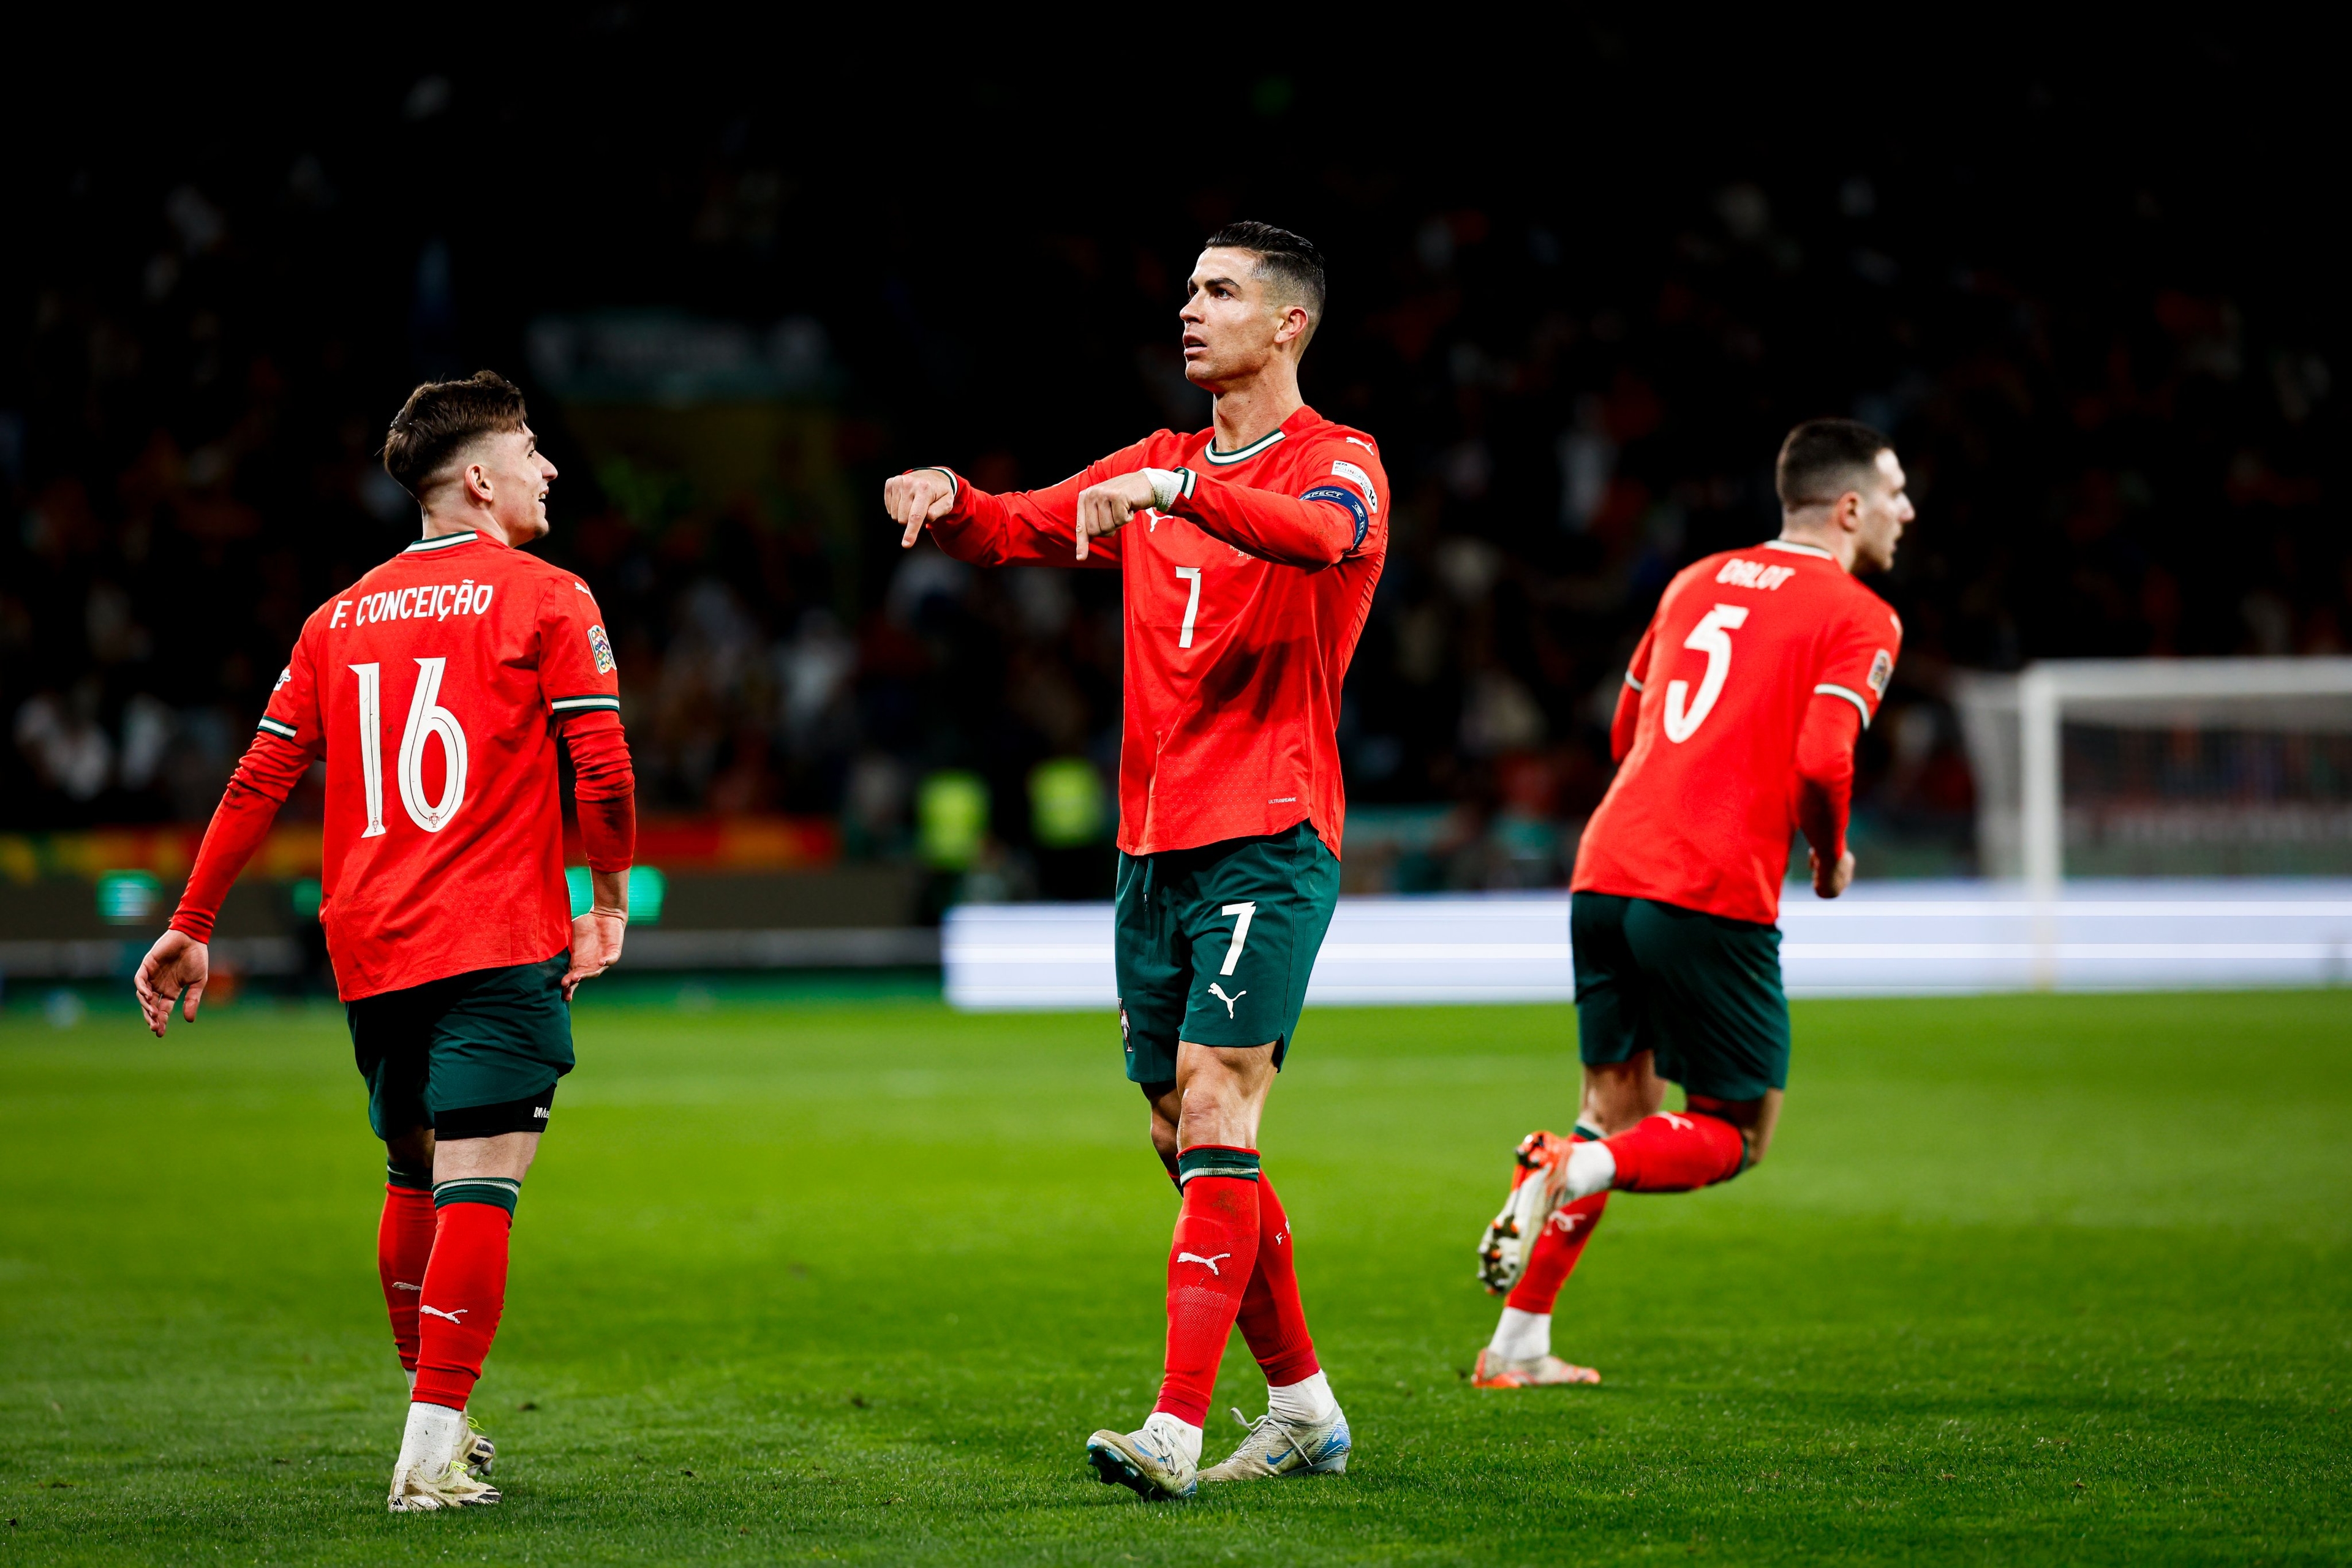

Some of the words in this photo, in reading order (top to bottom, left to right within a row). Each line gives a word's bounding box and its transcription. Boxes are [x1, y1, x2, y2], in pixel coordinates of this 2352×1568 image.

[330, 600, 353, 628] F.
[356, 579, 492, 626] CONCEIÇÃO
[1175, 566, 1201, 649] 7
[1663, 603, 1750, 744] 5
[347, 657, 468, 839] 16
[1219, 901, 1256, 976] 7
